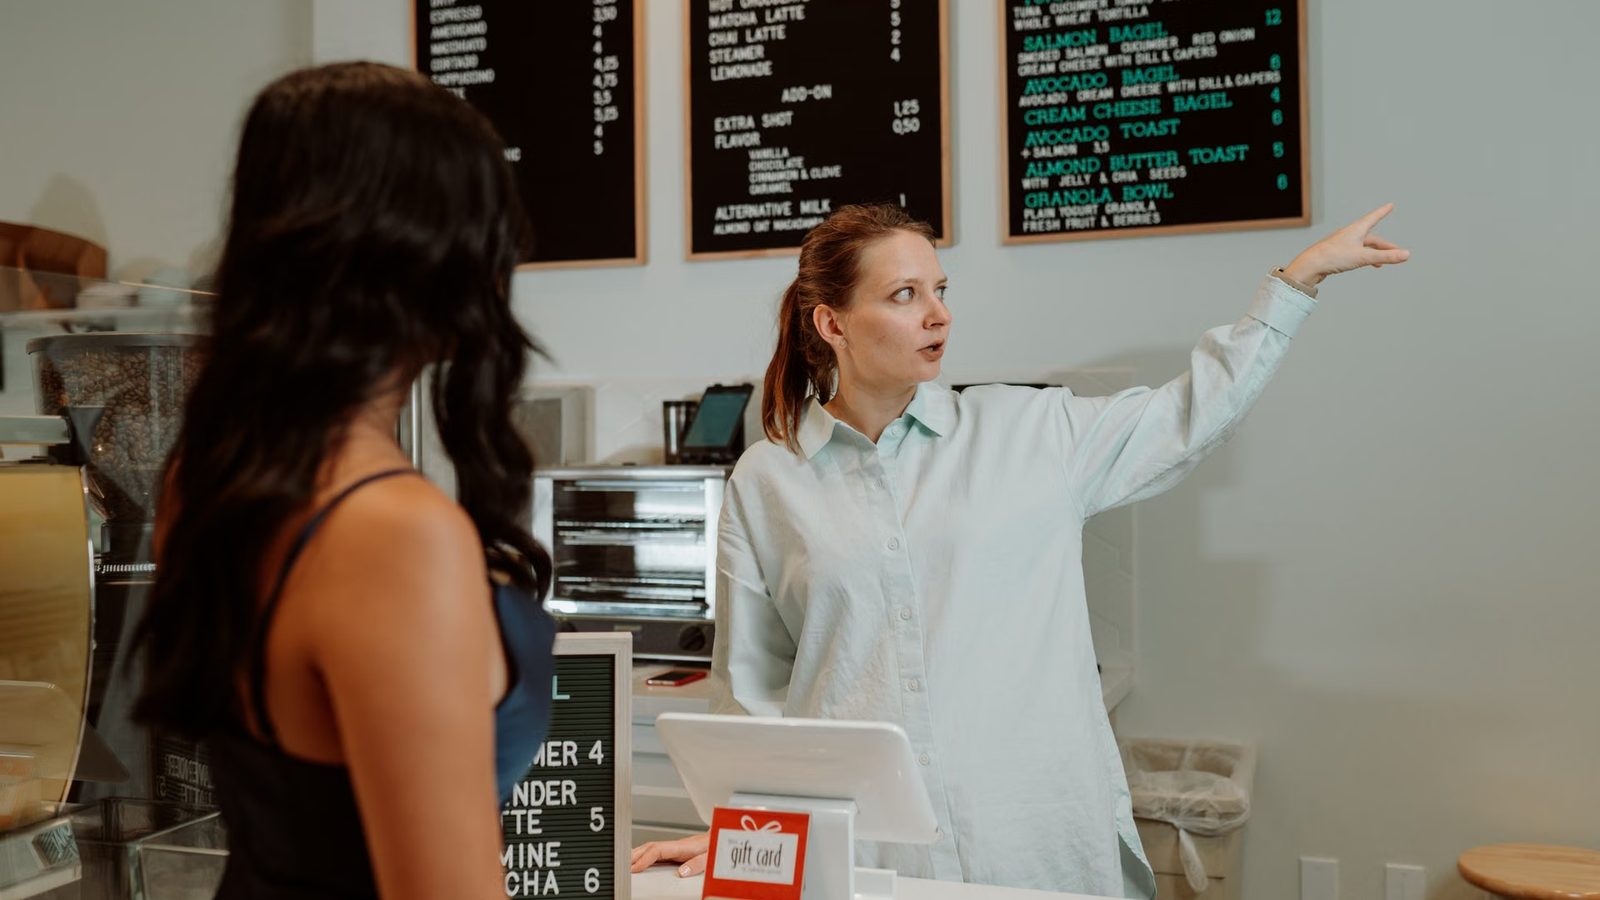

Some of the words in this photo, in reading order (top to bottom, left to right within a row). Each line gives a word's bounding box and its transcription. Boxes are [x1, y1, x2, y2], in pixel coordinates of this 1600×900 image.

[708, 11, 758, 29] MATCHA
[765, 4, 806, 23] LATTE
[890, 11, 901, 27] 5
[1013, 15, 1051, 31] WHOLE
[1055, 11, 1092, 27] WHEAT
[1098, 5, 1149, 22] TORTILLA
[1265, 8, 1281, 26] 12
[592, 23, 602, 38] 4
[708, 29, 738, 47] CHAI
[745, 24, 787, 43] LATTE
[891, 29, 901, 45] 2
[1023, 28, 1097, 51] SALMON
[1109, 21, 1168, 43] BAGEL
[592, 40, 602, 55] 4
[709, 45, 765, 64] STEAMER
[890, 47, 901, 62] 4
[1066, 44, 1109, 60] SALMON
[1192, 31, 1216, 46] RED
[1219, 28, 1256, 44] ONION
[711, 61, 773, 81] LEMONADE
[1017, 60, 1056, 76] CREAM
[1059, 57, 1100, 73] CHEESE
[1104, 54, 1132, 68] WITH
[1135, 51, 1160, 66] DILL
[1162, 50, 1171, 62] &
[1173, 45, 1217, 61] CAPERS
[1018, 92, 1068, 107] AVOCADO
[1076, 86, 1114, 102] CREAM
[1120, 82, 1162, 98] CHEESE
[1167, 79, 1196, 93] WITH
[1199, 75, 1224, 90] DILL
[1235, 70, 1281, 87] CAPERS
[1024, 72, 1108, 95] AVOCADO
[1121, 65, 1179, 85] BAGEL
[781, 84, 832, 103] ADD-ON
[1271, 86, 1281, 103] 4
[1024, 105, 1087, 126] CREAM
[1093, 99, 1161, 121] CHEESE
[1173, 92, 1233, 113] BAGEL
[714, 115, 755, 132] EXTRA
[761, 111, 794, 128] SHOT
[1025, 124, 1110, 147] AVOCADO
[1120, 118, 1181, 139] TOAST
[714, 132, 761, 149] FLAVOR
[748, 147, 789, 159] VANILLA
[748, 156, 804, 173] CHOCOLATE
[1025, 155, 1100, 177] ALMOND
[1110, 150, 1179, 172] BUTTER
[1189, 144, 1249, 165] TOAST
[800, 168, 809, 180] &
[810, 164, 842, 179] CLOVE
[1022, 177, 1049, 190] WITH
[1059, 173, 1092, 188] JELLY
[1100, 172, 1108, 185] &
[1112, 169, 1139, 183] CHIA
[1149, 165, 1187, 181] SEEDS
[1025, 187, 1112, 208] GRANOLA
[1123, 183, 1174, 202] BOWL
[715, 201, 792, 221] ALTERNATIVE
[800, 198, 831, 214] MILK
[1023, 207, 1056, 220] PLAIN
[1059, 203, 1098, 218] YOGURT
[1105, 200, 1156, 215] GRANOLA
[1023, 219, 1061, 232] FRESH
[1066, 216, 1097, 230] FRUIT
[1101, 215, 1110, 228] &
[1113, 212, 1161, 227] BERRIES
[588, 740, 604, 765] 4
[505, 780, 577, 807] NDER
[589, 807, 605, 832] 5
[731, 840, 752, 869] gift
[756, 842, 783, 868] card
[584, 867, 600, 894] 6
